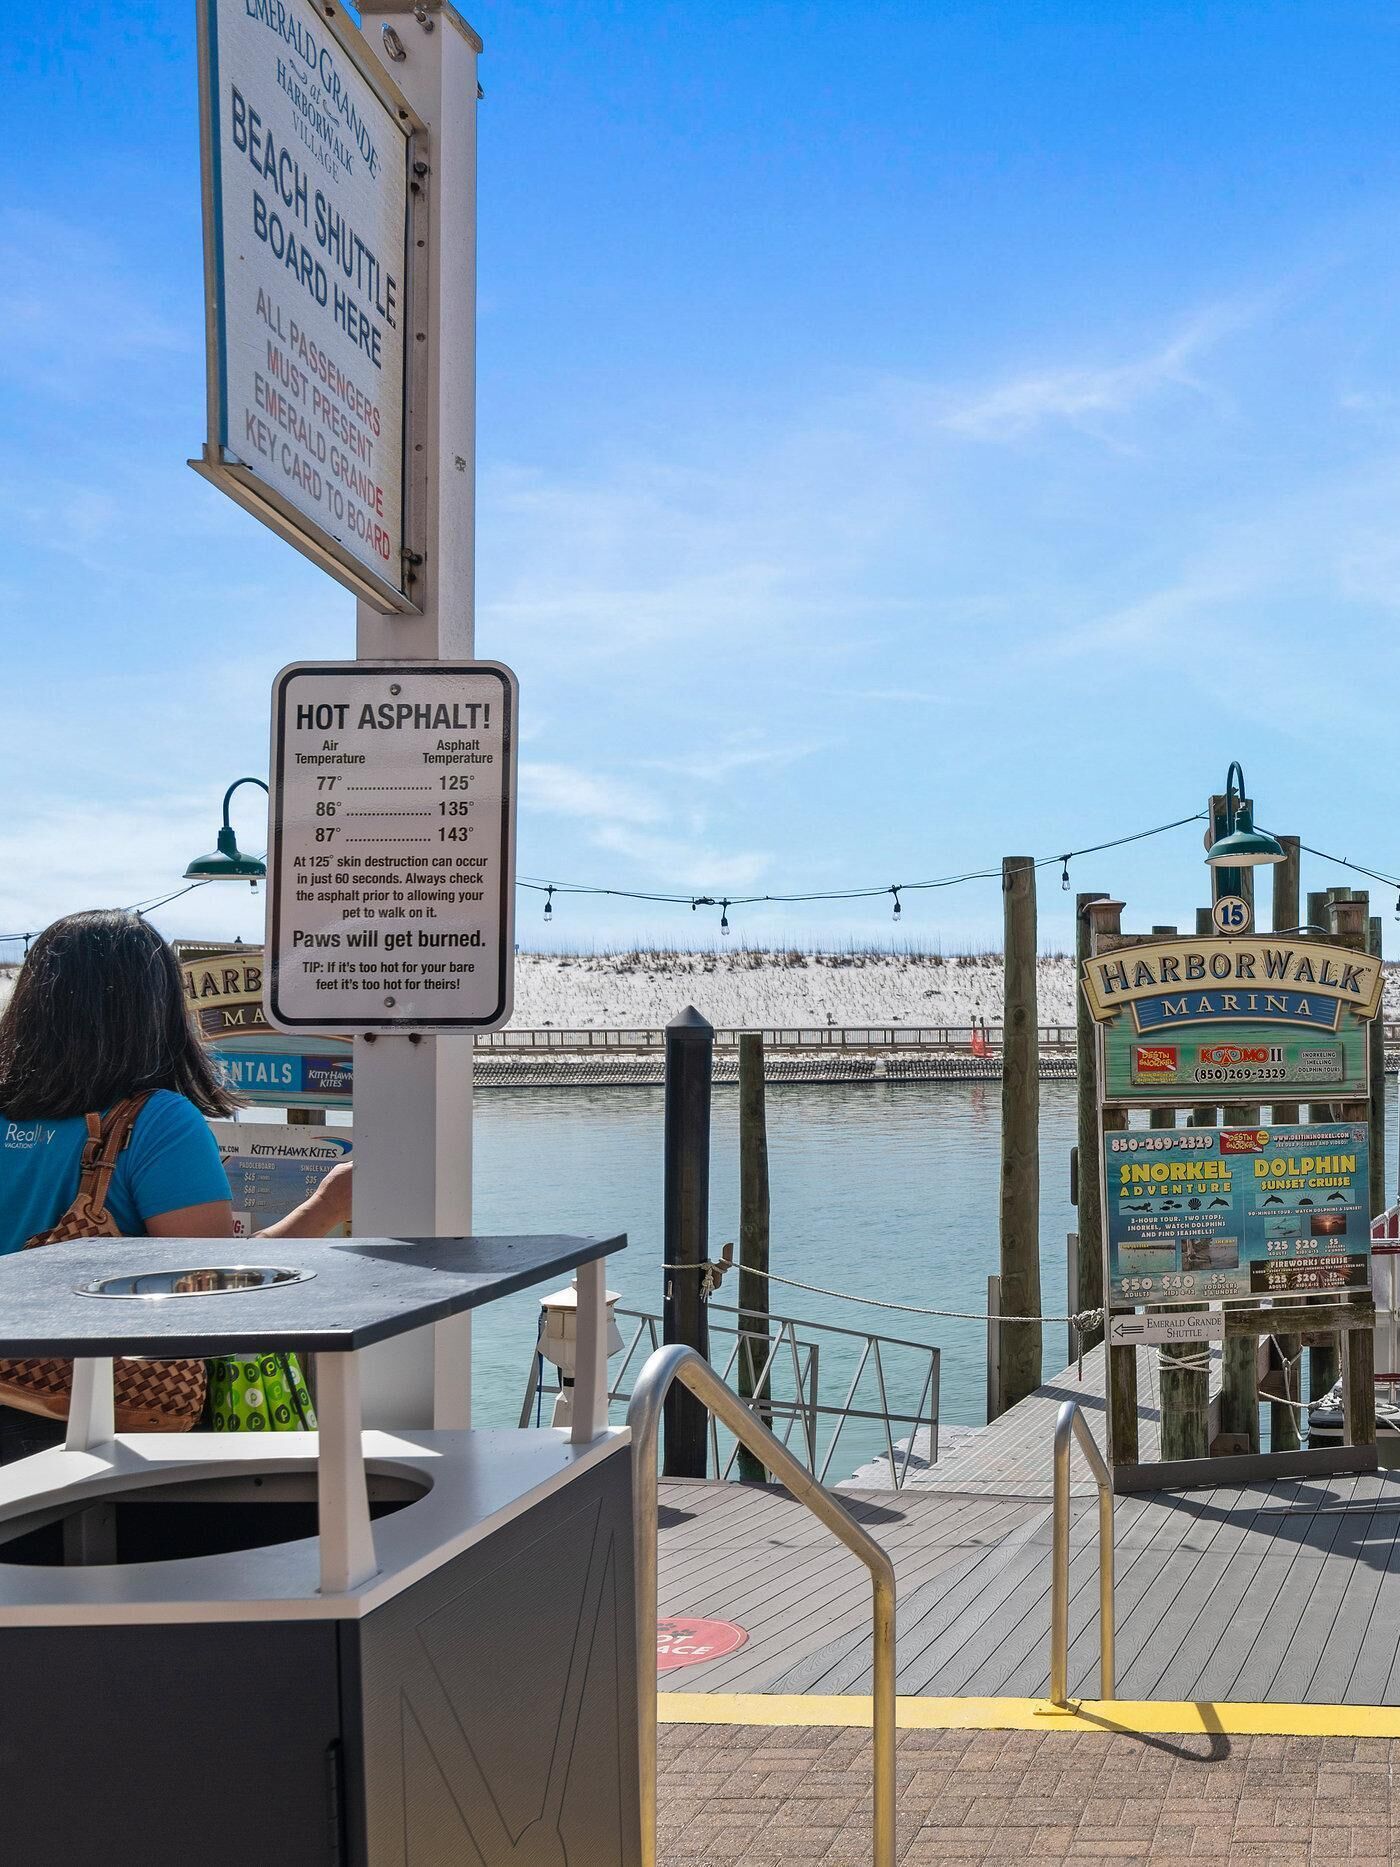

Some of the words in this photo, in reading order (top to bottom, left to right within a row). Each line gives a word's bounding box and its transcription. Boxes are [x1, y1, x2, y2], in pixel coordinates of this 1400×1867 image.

[310, 84, 320, 104] at
[277, 57, 354, 175] HARBORWALK
[320, 48, 379, 179] GRANDE
[292, 110, 338, 180] VILLAGE
[232, 83, 308, 228] BEACH
[314, 189, 396, 329] SHUTTLE
[253, 188, 328, 308] BOARD
[334, 282, 382, 370] HERE
[256, 287, 287, 343] ALL
[290, 319, 381, 437] PASSENGERS
[267, 338, 309, 406] MUST
[312, 385, 373, 468] PRESENT
[254, 371, 326, 464] EMERALD
[330, 445, 384, 518] GRANDE
[245, 408, 278, 462] KEY
[281, 443, 322, 501] CARD
[325, 479, 343, 521] TO
[347, 499, 391, 561] BOARD
[296, 704, 350, 730] HOT
[357, 703, 490, 730] ASPHALT!
[322, 740, 339, 750] Air
[436, 739, 480, 752] Asphalt
[295, 753, 366, 766] Temperature
[422, 752, 494, 766] Temperature
[316, 776, 342, 790] 77°
[439, 775, 474, 790] 125°
[316, 801, 342, 816] 86°
[438, 801, 474, 816] 135°
[315, 827, 341, 842] 87°
[438, 826, 474, 842] 143°
[293, 856, 306, 867] At
[309, 854, 334, 867] 125°
[337, 856, 361, 867] skin
[364, 856, 428, 867] destruction
[432, 858, 452, 867] can
[456, 858, 488, 867] occur
[297, 873, 308, 884] in
[310, 873, 332, 886] just
[335, 873, 349, 884] 60
[352, 873, 402, 884] seconds.
[405, 873, 446, 886] Always
[450, 873, 484, 884] check
[296, 890, 314, 901] the
[317, 890, 360, 904] asphalt
[362, 890, 390, 904] prior
[392, 891, 404, 901] to
[407, 890, 456, 904] allowing
[458, 892, 484, 903] your
[342, 908, 361, 920] pet
[364, 908, 375, 918] to
[378, 907, 406, 918] walk
[408, 910, 422, 918] on
[426, 907, 438, 918] it.
[1221, 904, 1243, 926] 15
[292, 930, 341, 948] Paws
[346, 930, 378, 948] will
[384, 931, 413, 951] get
[418, 930, 486, 948] burned.
[302, 962, 324, 972] TIP:
[327, 962, 336, 972] If
[338, 962, 356, 973] it's
[358, 962, 378, 973] too
[380, 962, 399, 973] hot
[402, 962, 418, 972] for
[421, 964, 446, 975] your
[450, 962, 475, 972] bare
[316, 979, 338, 990] feet
[341, 979, 359, 990] it's
[362, 980, 380, 990] too
[384, 979, 402, 990] hot
[405, 979, 421, 990] for
[424, 978, 460, 990] theirs!
[1161, 994, 1313, 1018] MARINA
[1139, 1058, 1176, 1066] SNORKEL
[1142, 1051, 1170, 1059] DESTIN
[1270, 1048, 1282, 1062] II
[308, 1070, 330, 1080] KITTY
[330, 1070, 353, 1081] HAWK
[1194, 1068, 1287, 1082] (850)269-2329
[320, 1079, 342, 1088] KITES
[1273, 1132, 1350, 1140] WWW.DESTINSNORKEL.COM
[250, 1144, 279, 1155] KITTY
[278, 1146, 308, 1157] HAWK
[309, 1147, 338, 1158] KITES
[1111, 1136, 1214, 1152] 850-269-2329
[1226, 1141, 1257, 1150] SNORKEL
[240, 1162, 276, 1170] PADDLEBOARD
[300, 1164, 320, 1172] SINGLE
[1120, 1160, 1232, 1185] SNORKEL
[1254, 1155, 1357, 1178] DOLPHIN
[1120, 1182, 1232, 1197] ADVENTURE
[1261, 1179, 1306, 1191] SUNSET
[1308, 1177, 1351, 1188] CRUISE
[1128, 1224, 1162, 1232] SNORKEL,
[1266, 1240, 1289, 1252] $25
[1296, 1239, 1318, 1250] $20
[1330, 1238, 1338, 1246] $5
[1270, 1260, 1318, 1268] FIREWORKS
[1320, 1256, 1348, 1265] CRUISE
[1121, 1278, 1153, 1292] $50
[1162, 1275, 1194, 1290] $40
[1211, 1274, 1226, 1284] $5
[1268, 1275, 1288, 1284] $25
[1296, 1274, 1316, 1282] $20
[1146, 1318, 1186, 1329] EMERALD
[1187, 1316, 1222, 1327] GRANDE
[1166, 1328, 1202, 1339] SHUTTLE
